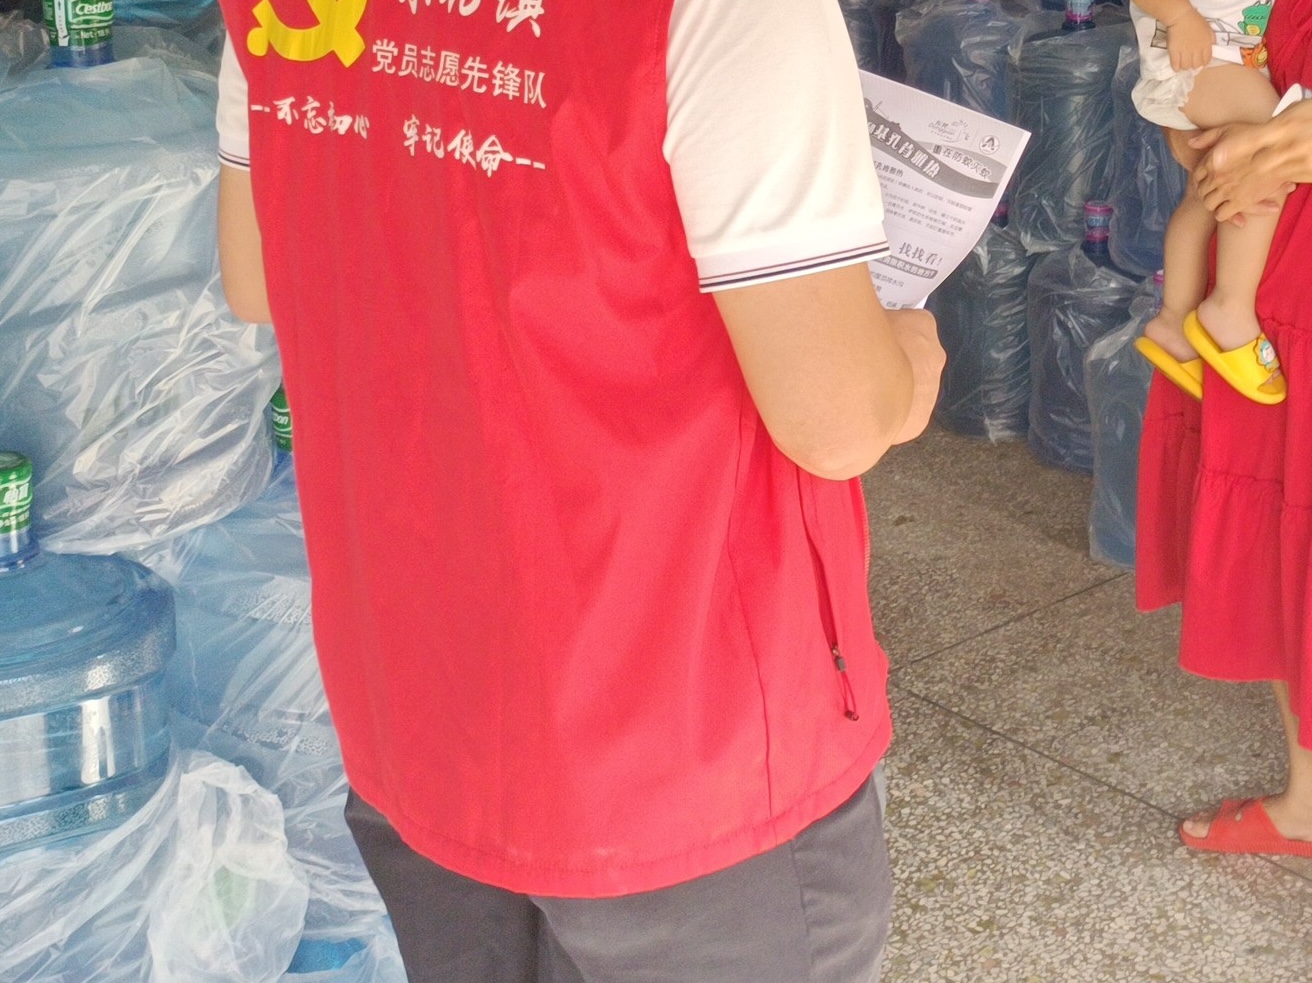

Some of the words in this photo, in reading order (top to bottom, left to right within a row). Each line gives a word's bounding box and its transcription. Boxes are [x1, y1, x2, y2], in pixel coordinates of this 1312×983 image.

[371, 36, 548, 110] 党员志愿先锋队
[274, 94, 371, 141] 不忘初心
[401, 113, 510, 178] 牢记使命
